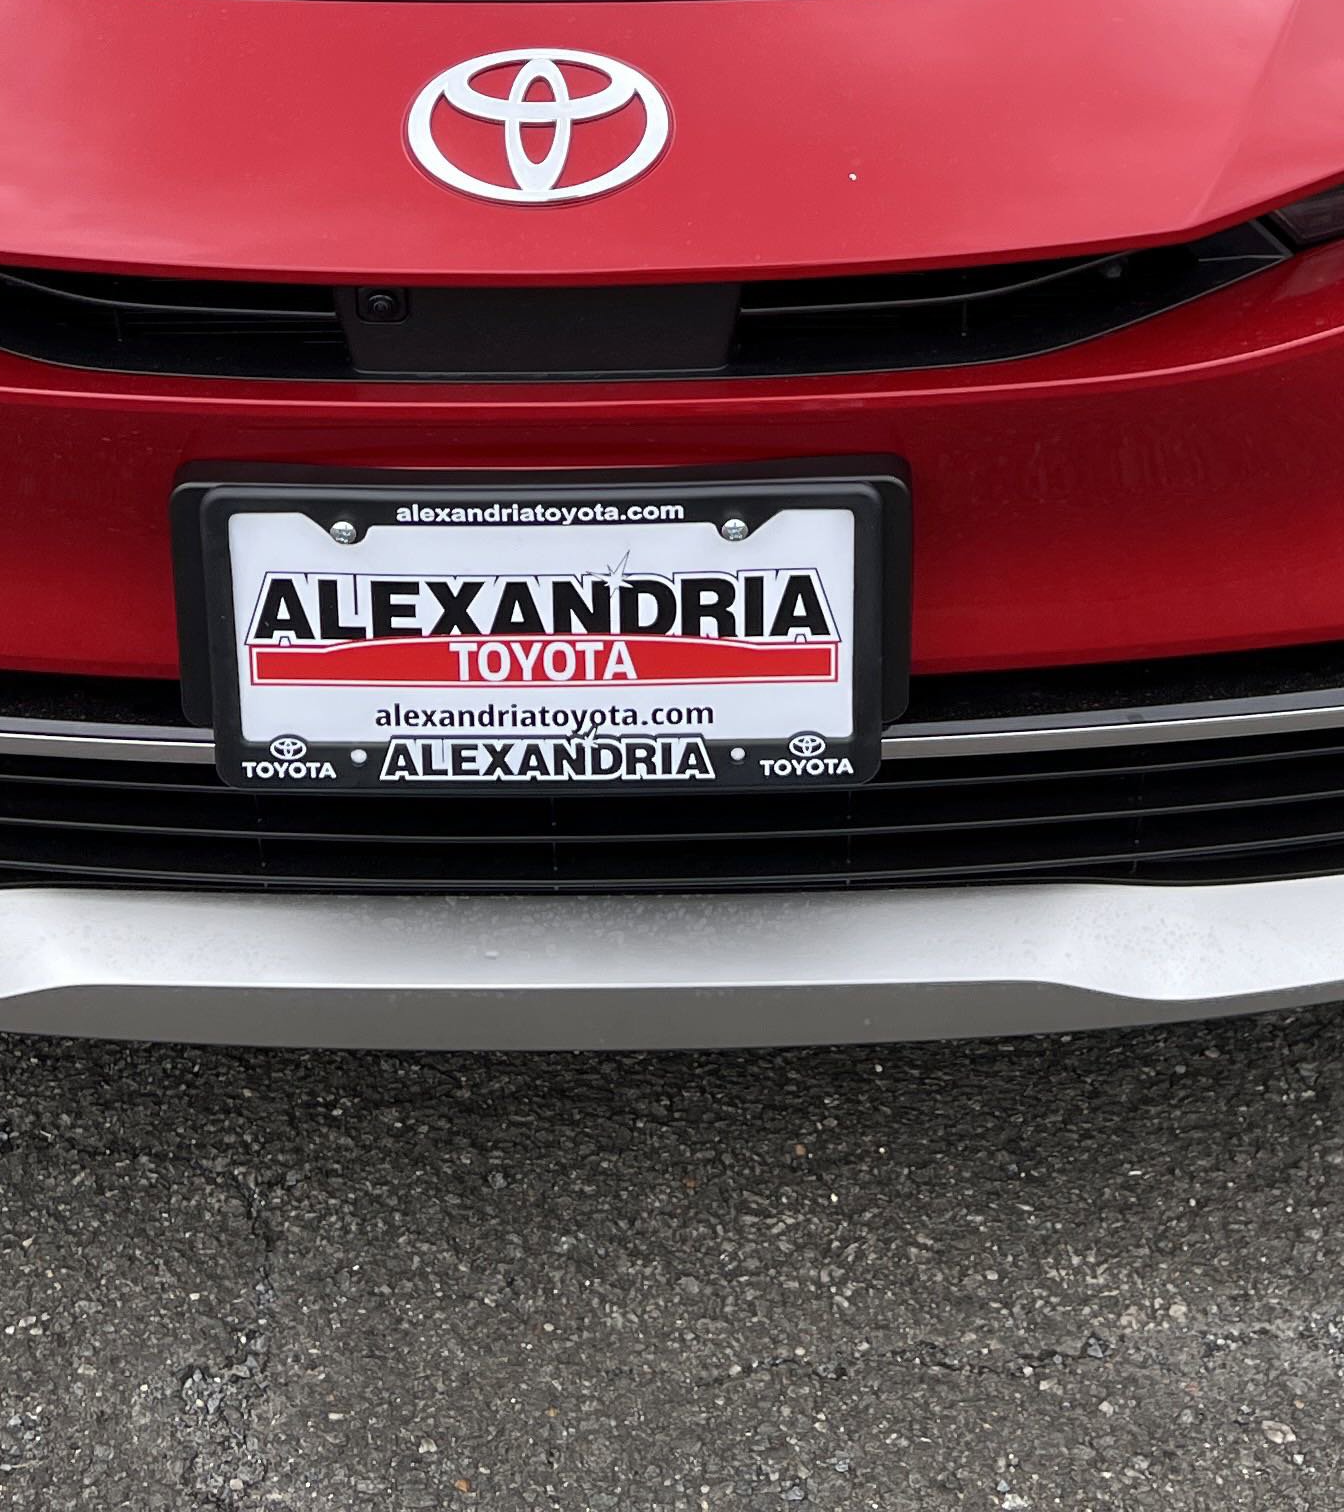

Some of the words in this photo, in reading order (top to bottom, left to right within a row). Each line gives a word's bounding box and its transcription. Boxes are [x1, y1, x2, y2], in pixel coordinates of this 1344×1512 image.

[396, 502, 684, 525] alexandriatoyota.com
[254, 572, 832, 641] ALEXANDRIA
[449, 641, 638, 681] TOYOTA
[375, 703, 714, 732] alexandriatoyota.com
[242, 761, 337, 779] TOYOTA
[381, 737, 714, 781] ALEXANDRIA
[760, 758, 854, 776] TOYOTA
